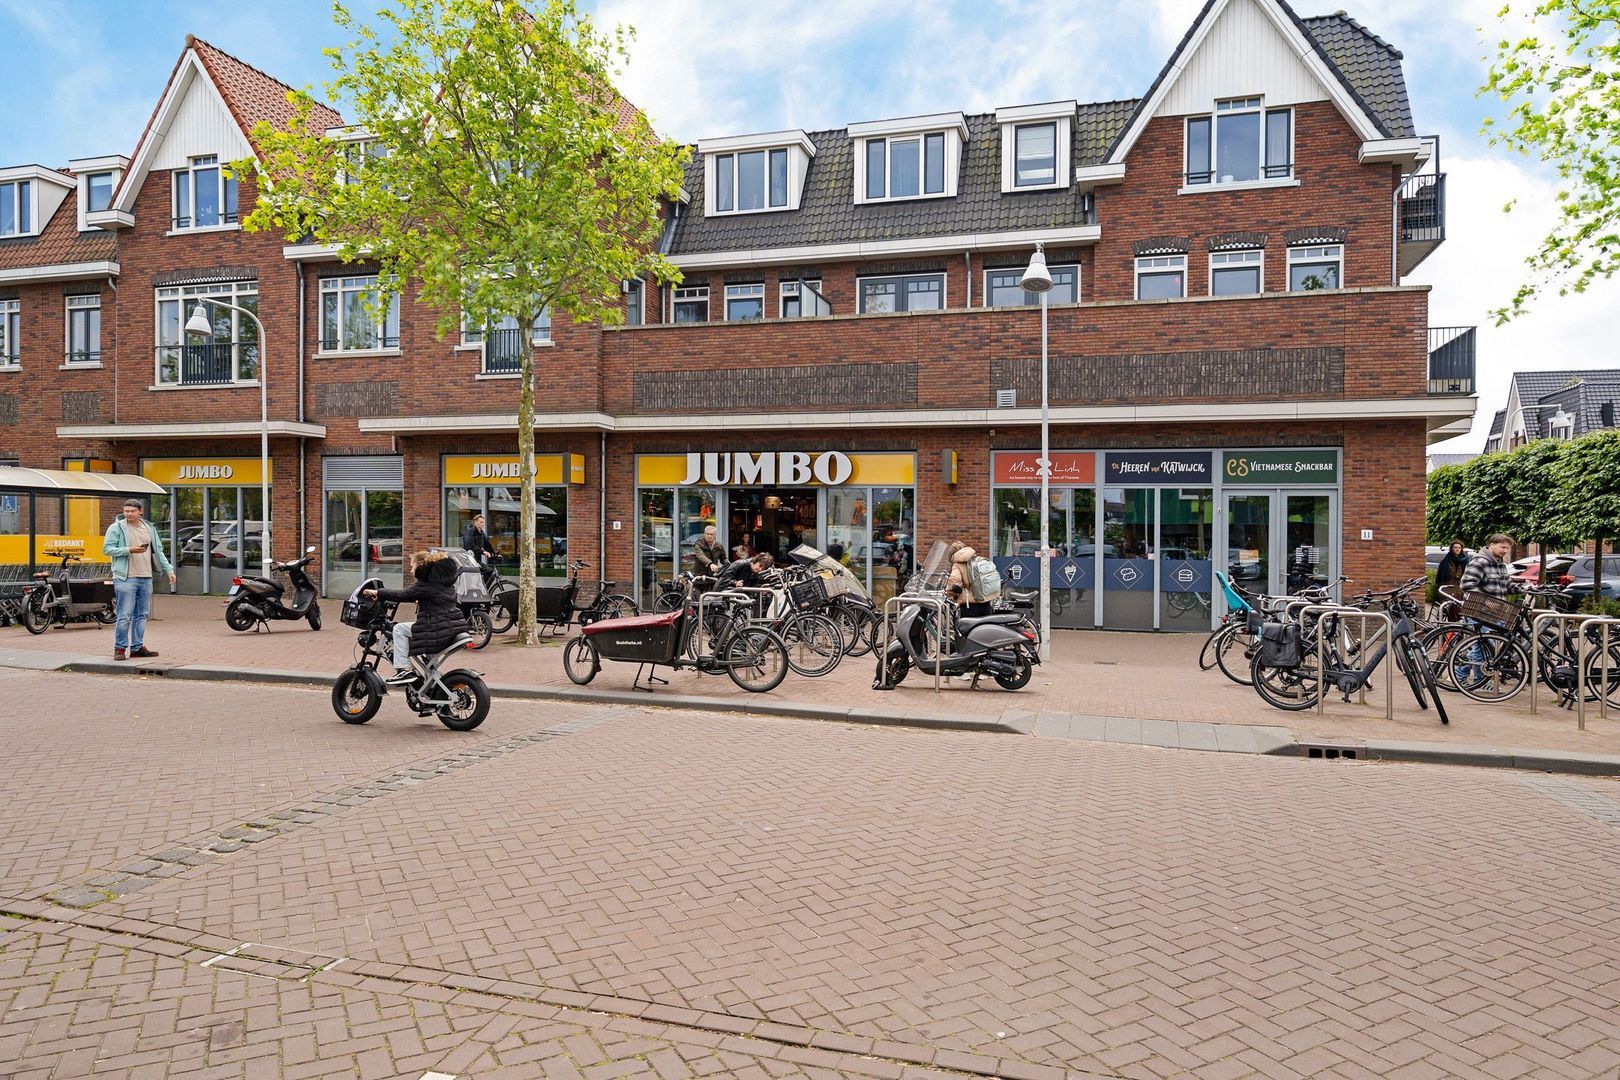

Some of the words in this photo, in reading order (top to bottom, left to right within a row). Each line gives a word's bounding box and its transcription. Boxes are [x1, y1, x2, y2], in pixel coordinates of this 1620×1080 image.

[178, 464, 233, 479] JUMBO
[471, 462, 539, 478] JUMB
[680, 451, 852, 486] JUMBO
[1008, 460, 1035, 473] Miss
[1054, 460, 1080, 473] Linh
[1227, 458, 1249, 477] CS
